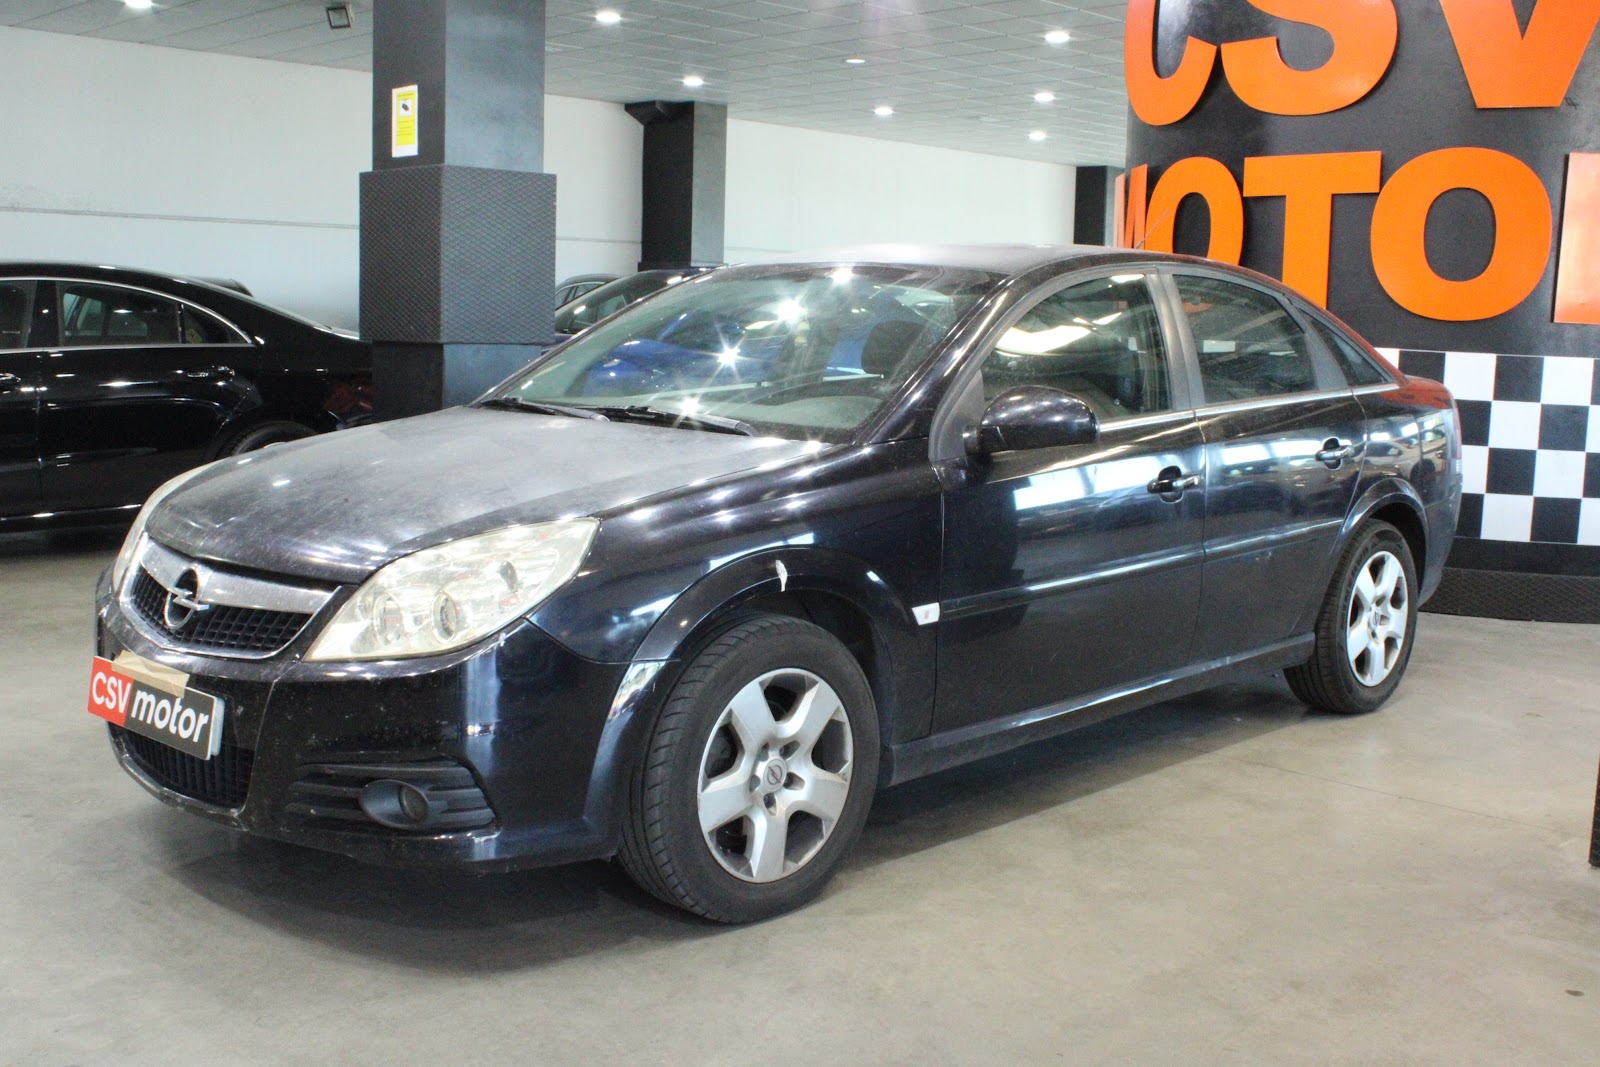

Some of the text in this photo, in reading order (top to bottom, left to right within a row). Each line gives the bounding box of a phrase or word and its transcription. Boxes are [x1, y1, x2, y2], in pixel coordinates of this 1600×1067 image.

[1114, 146, 1600, 324] MOTO
[92, 672, 209, 742] CSV motor
